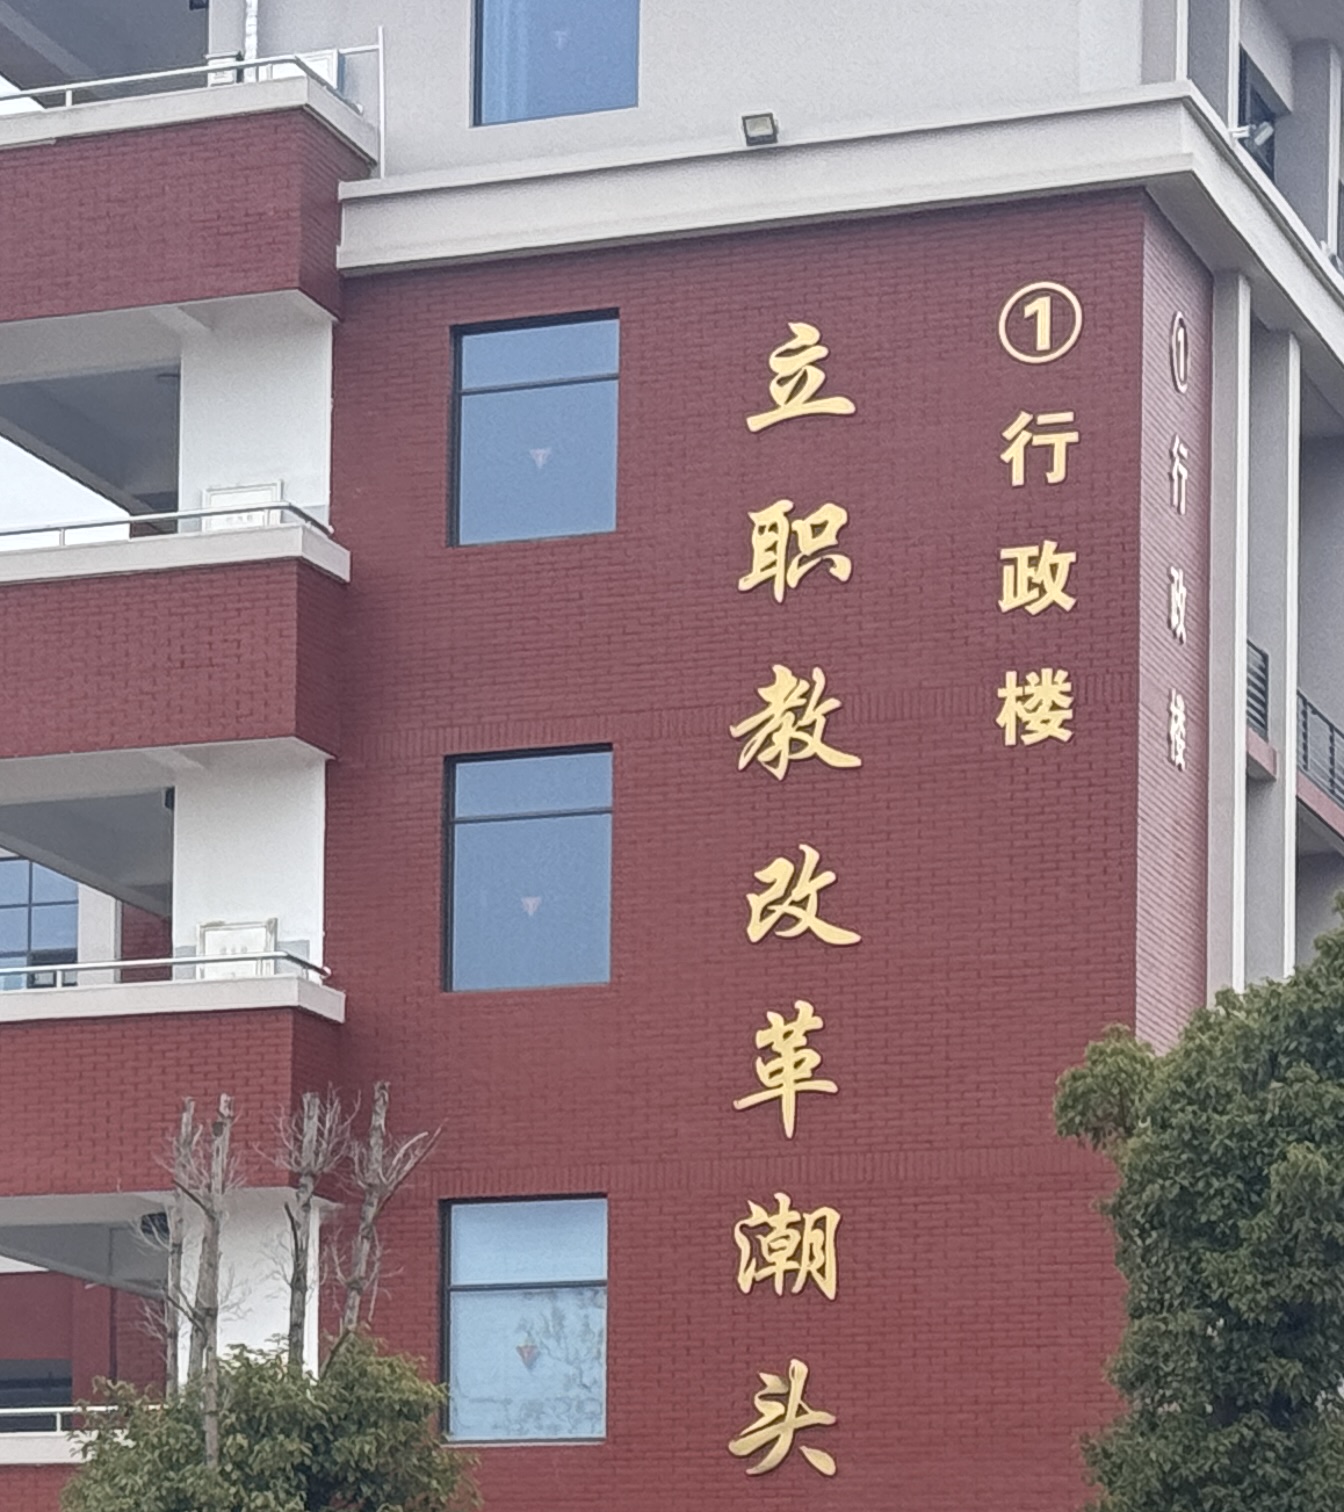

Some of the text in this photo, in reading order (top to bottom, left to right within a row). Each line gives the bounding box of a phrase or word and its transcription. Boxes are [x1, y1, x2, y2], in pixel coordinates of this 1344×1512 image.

[728, 321, 863, 1476] 立职教改革潮头
